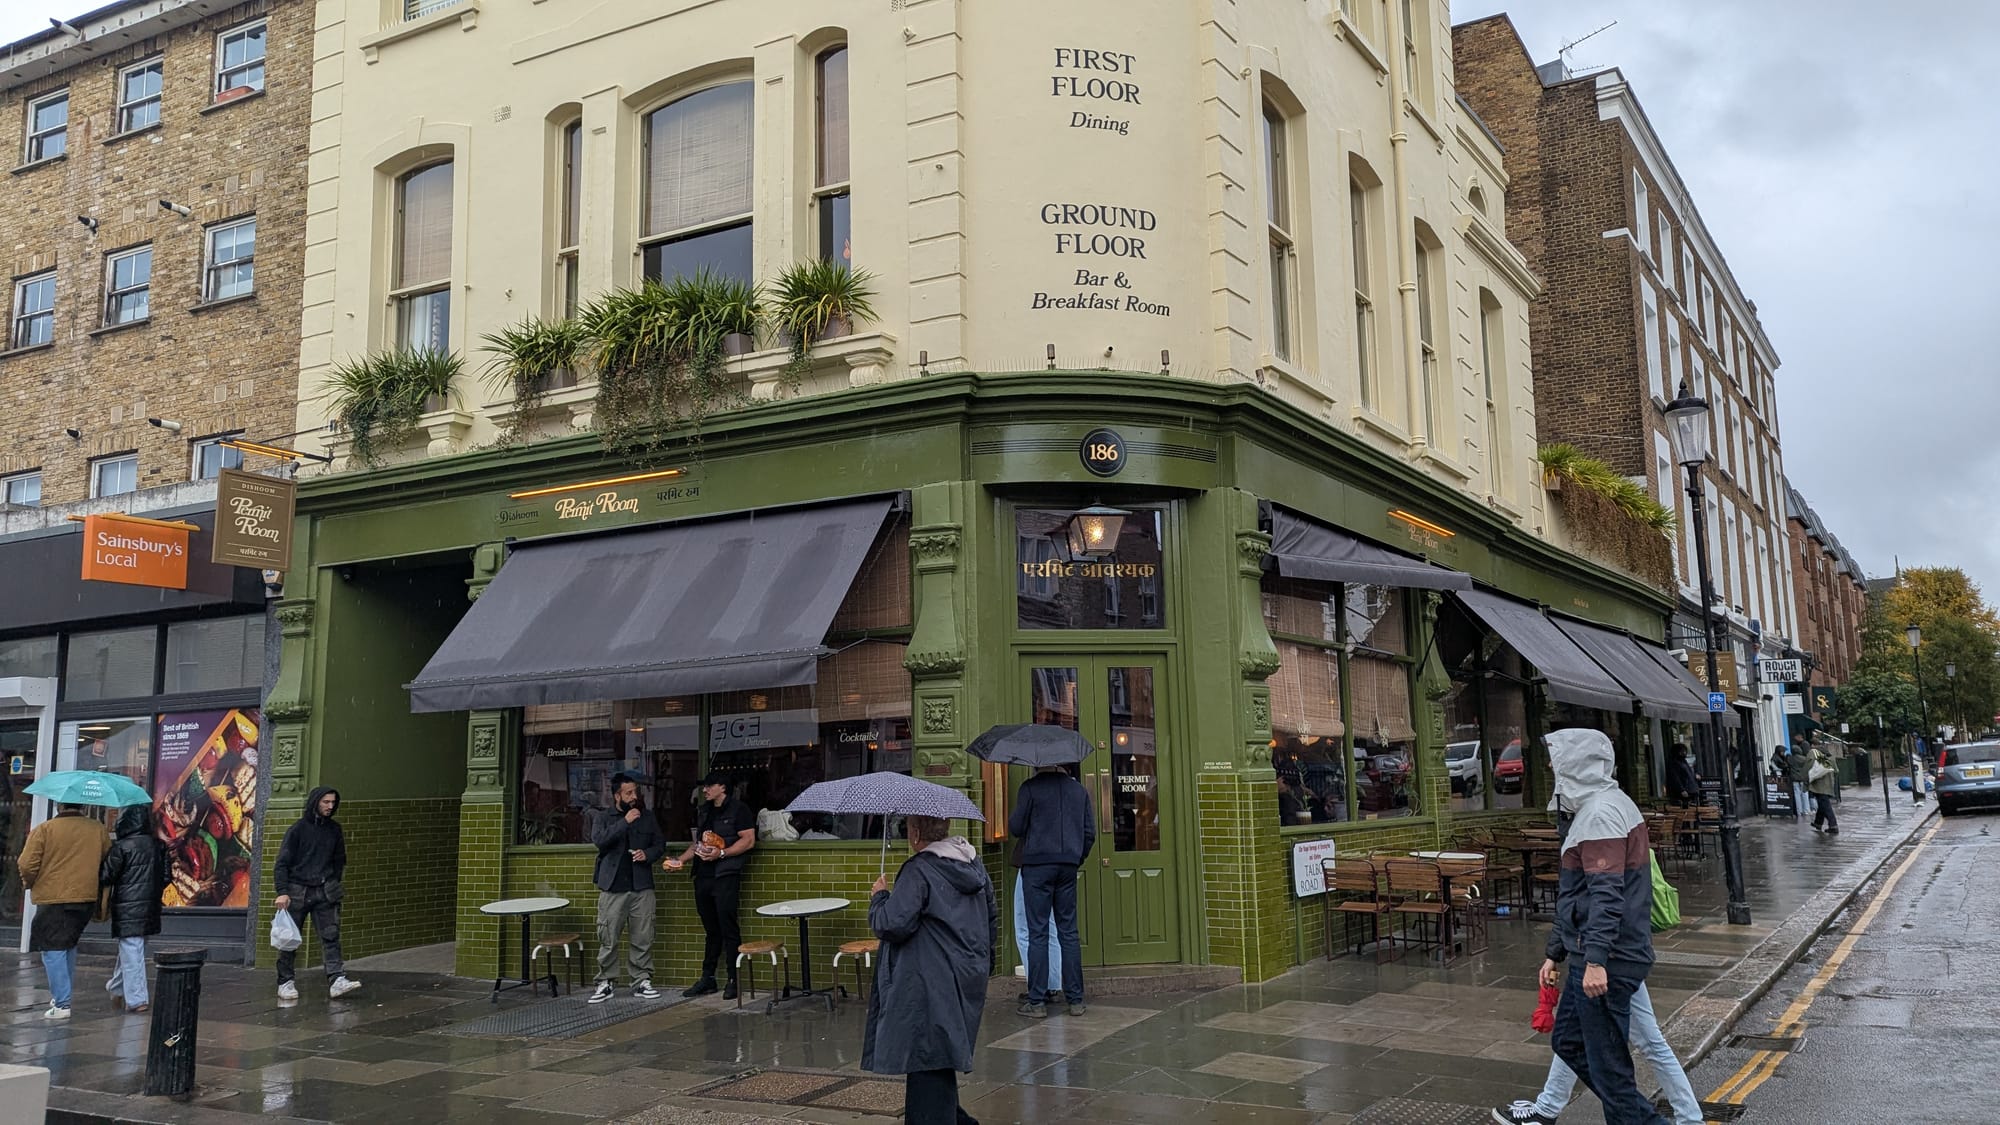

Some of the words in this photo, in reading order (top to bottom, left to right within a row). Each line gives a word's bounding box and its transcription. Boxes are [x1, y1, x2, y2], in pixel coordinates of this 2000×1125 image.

[1054, 47, 1137, 75] FIRST
[1051, 76, 1142, 105] FLOOR
[1069, 111, 1130, 136] Dining
[1041, 203, 1157, 231] GROUND
[1055, 233, 1147, 260] FLOOR
[1073, 269, 1109, 287] Bar
[1113, 271, 1132, 290] &
[1031, 292, 1121, 311] Breakfast
[1124, 295, 1171, 317] Room
[1089, 443, 1118, 461] 186
[241, 483, 276, 495] DISHOOM
[229, 496, 273, 522] Permit
[555, 498, 595, 521] Permit
[596, 492, 639, 514] Room
[499, 510, 539, 525] Dishoom
[234, 516, 280, 543] Room
[97, 531, 183, 558] Sainsbury's
[96, 549, 137, 568] Local
[1022, 558, 1075, 578] परमिट
[1080, 563, 1157, 578] आवश्यक
[1765, 660, 1797, 672] ROUGH
[1766, 671, 1798, 682] TRADE
[163, 724, 175, 732] Best
[175, 723, 181, 731] of
[181, 722, 200, 731] British
[162, 733, 176, 741] since
[839, 731, 879, 743] Cocktails!
[1117, 775, 1151, 784] PERMIT
[1121, 784, 1146, 793] ROOM
[1304, 863, 1327, 877] TALBO
[1300, 879, 1319, 893] ROAD
